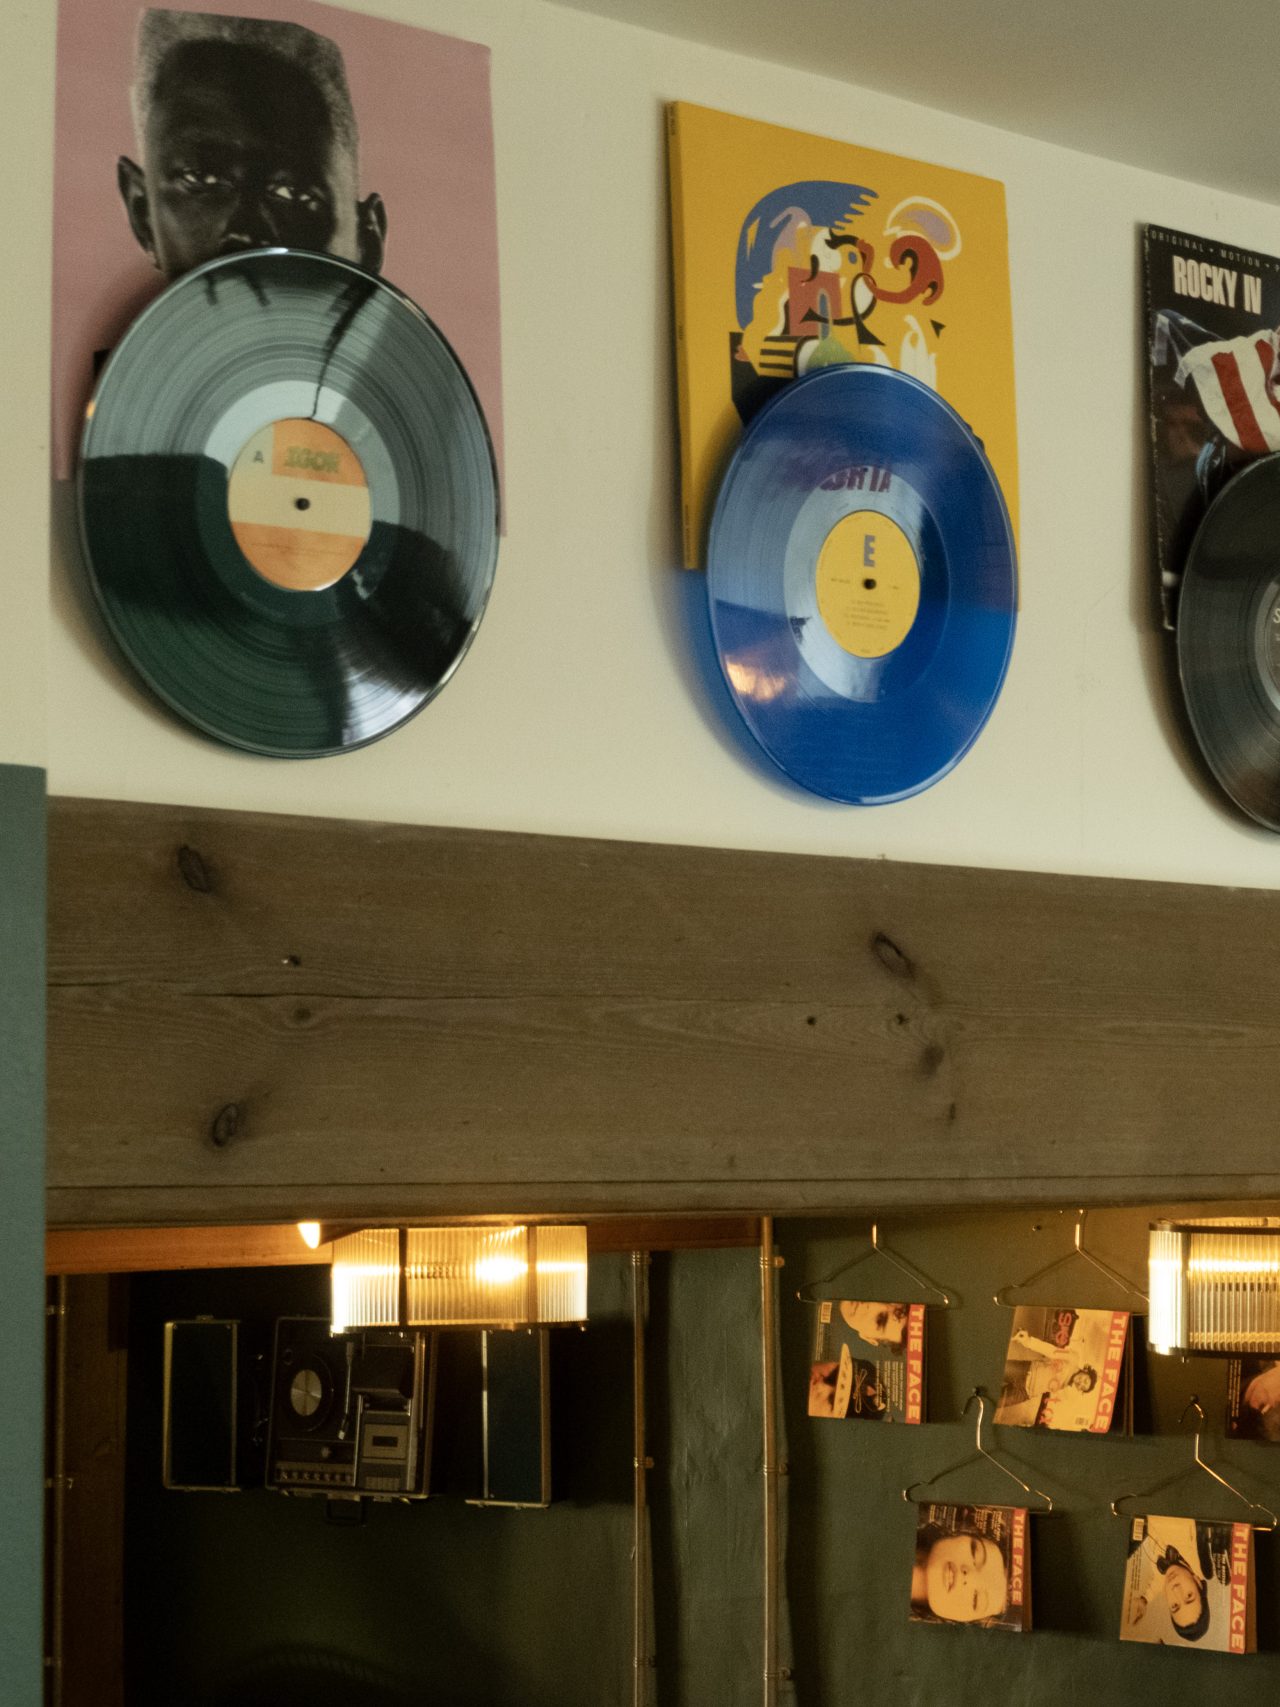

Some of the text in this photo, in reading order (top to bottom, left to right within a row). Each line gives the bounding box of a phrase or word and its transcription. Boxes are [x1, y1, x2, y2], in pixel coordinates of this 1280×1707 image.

[1151, 230, 1204, 252] ORIGINAL
[1221, 249, 1260, 268] MOTION
[1173, 255, 1261, 316] ROCKY IV
[907, 1308, 925, 1419] THE FACE
[1094, 1315, 1126, 1429] THE FACE
[1012, 1514, 1025, 1602] THE FACE
[1231, 1528, 1249, 1650] THE FACE
